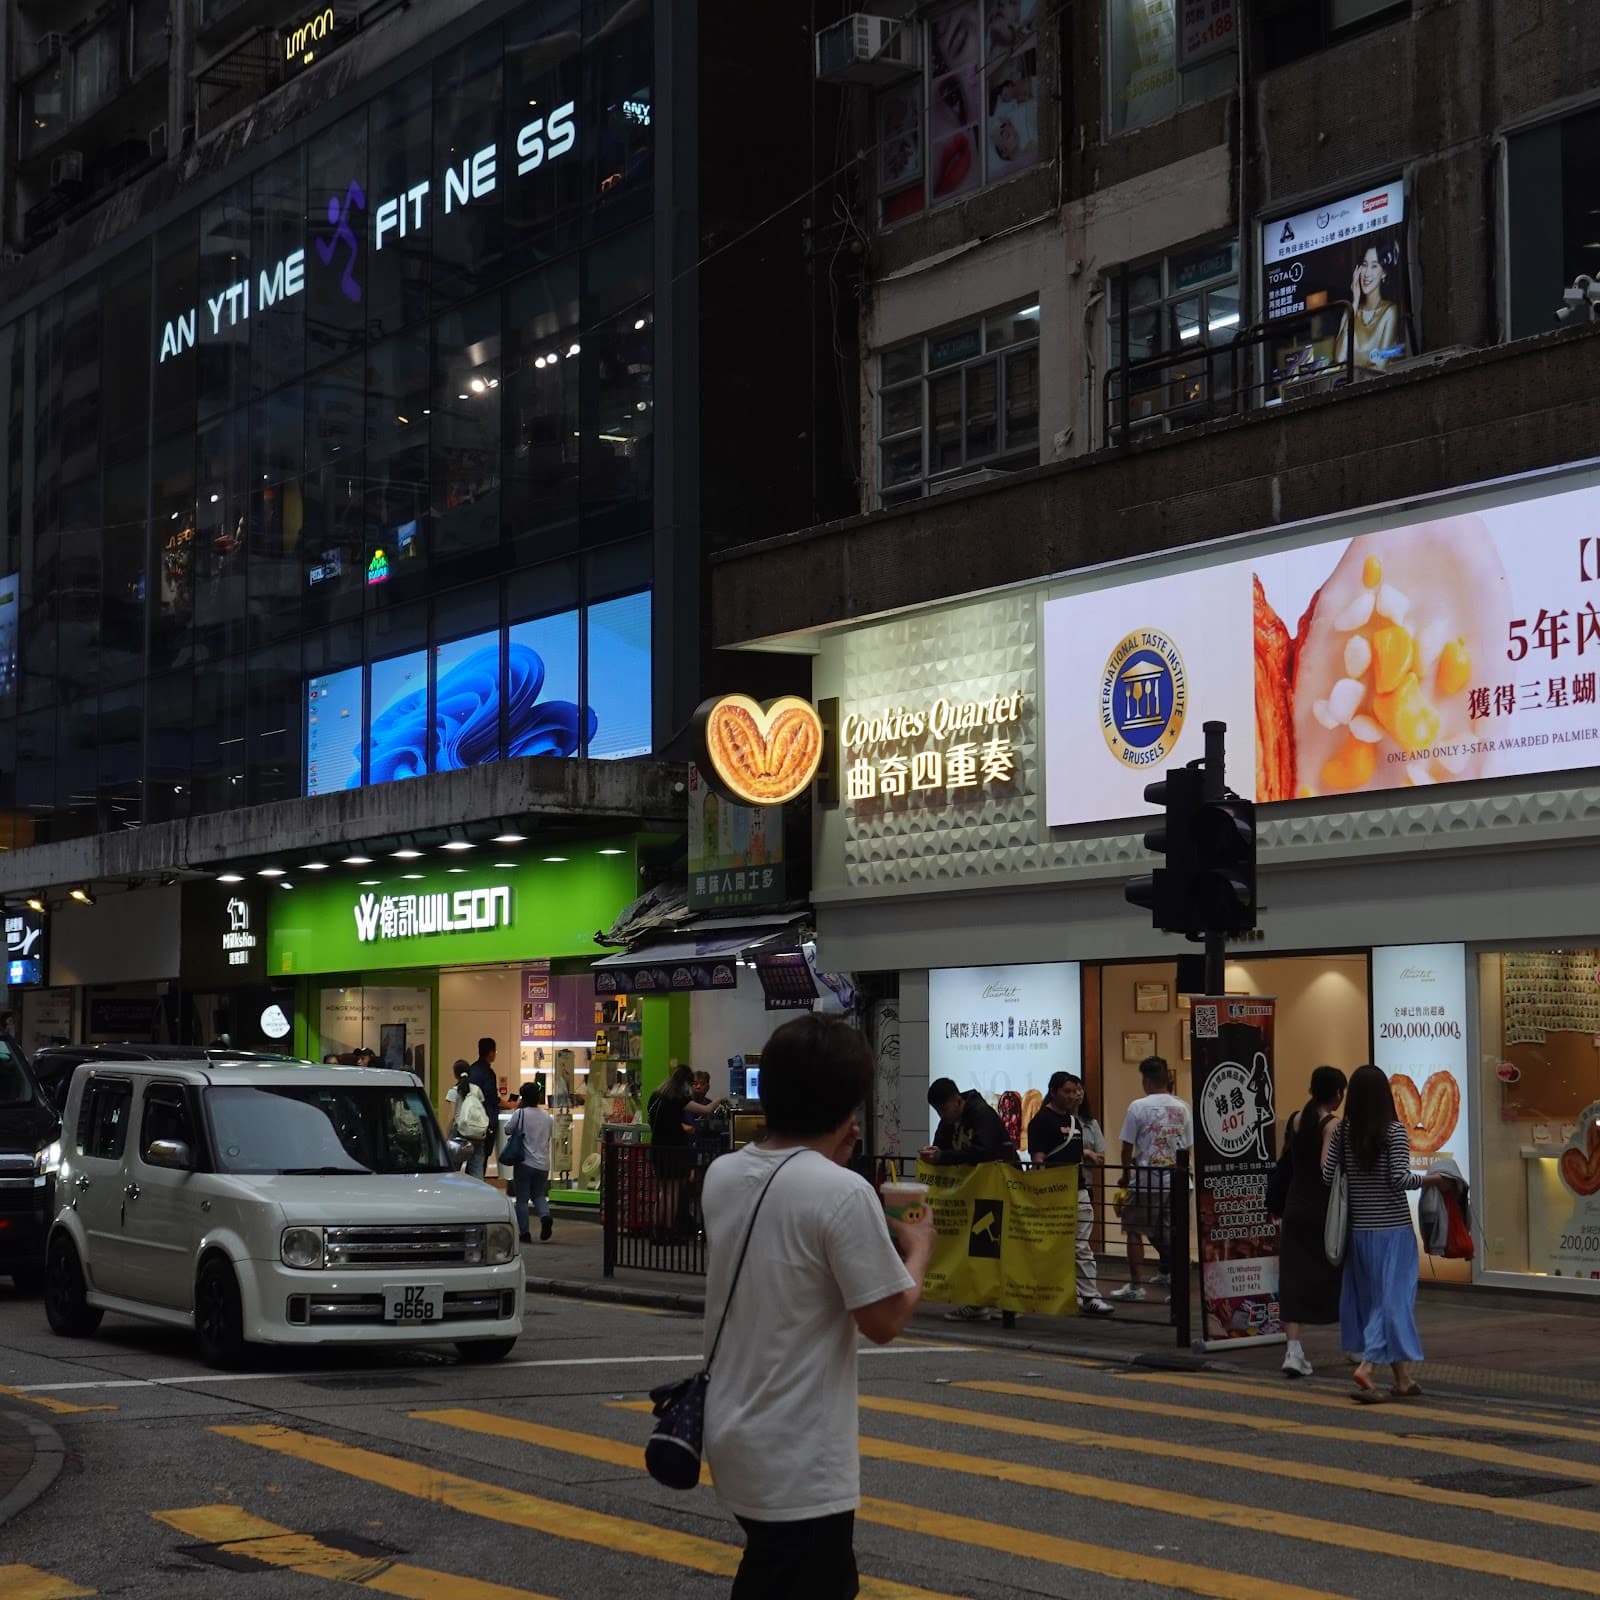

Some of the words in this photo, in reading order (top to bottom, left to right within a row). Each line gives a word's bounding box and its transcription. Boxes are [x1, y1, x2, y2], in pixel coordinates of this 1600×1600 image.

[1102, 637, 1139, 728] INTERNATIONAL
[1141, 633, 1168, 651] TASTE
[1166, 648, 1185, 718] INSTITUTE
[841, 706, 929, 748] Cookies
[929, 690, 1022, 740] Quartet
[1122, 742, 1165, 765] BRUSSELS
[1387, 752, 1407, 763] ONE
[1409, 749, 1430, 761] AND
[1432, 745, 1460, 759] ONLY
[1461, 742, 1497, 755] 3-STAR
[1498, 734, 1549, 751] AWARDED
[847, 738, 1014, 800] 曲奇四重奏
[418, 886, 512, 934] WILSON
[1222, 1111, 1245, 1134] 407
[405, 1286, 425, 1302] DZ
[394, 1303, 434, 1318] 9668
